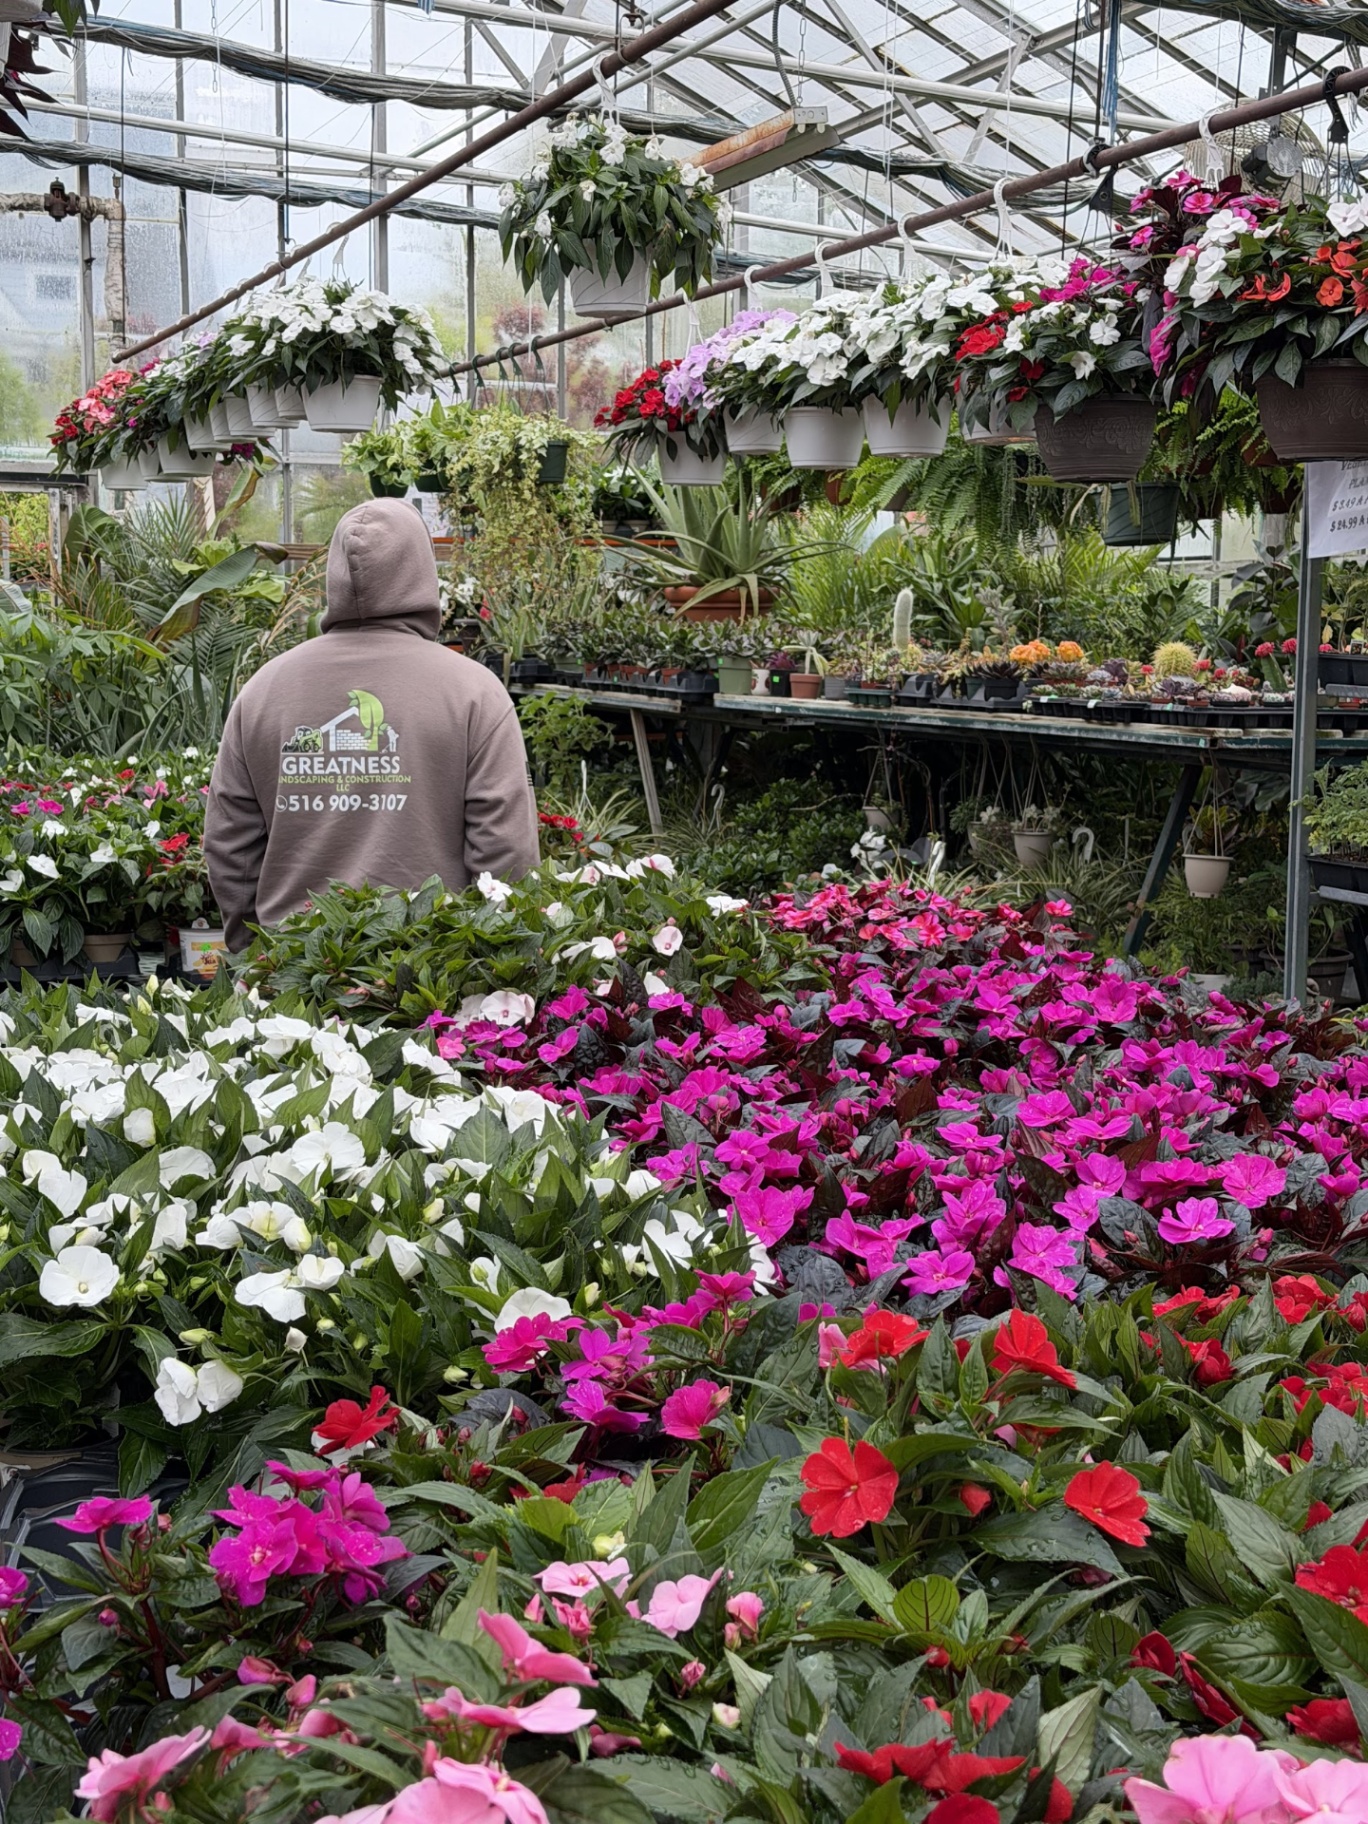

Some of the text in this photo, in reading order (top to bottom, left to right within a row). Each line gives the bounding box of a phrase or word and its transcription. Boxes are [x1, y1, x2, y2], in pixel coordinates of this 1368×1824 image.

[282, 756, 400, 775] GREATNESS
[279, 775, 412, 784] NDSCAPING & CONSTRUCTION
[336, 784, 350, 792] LLC
[288, 794, 408, 812] 516 909-3107
